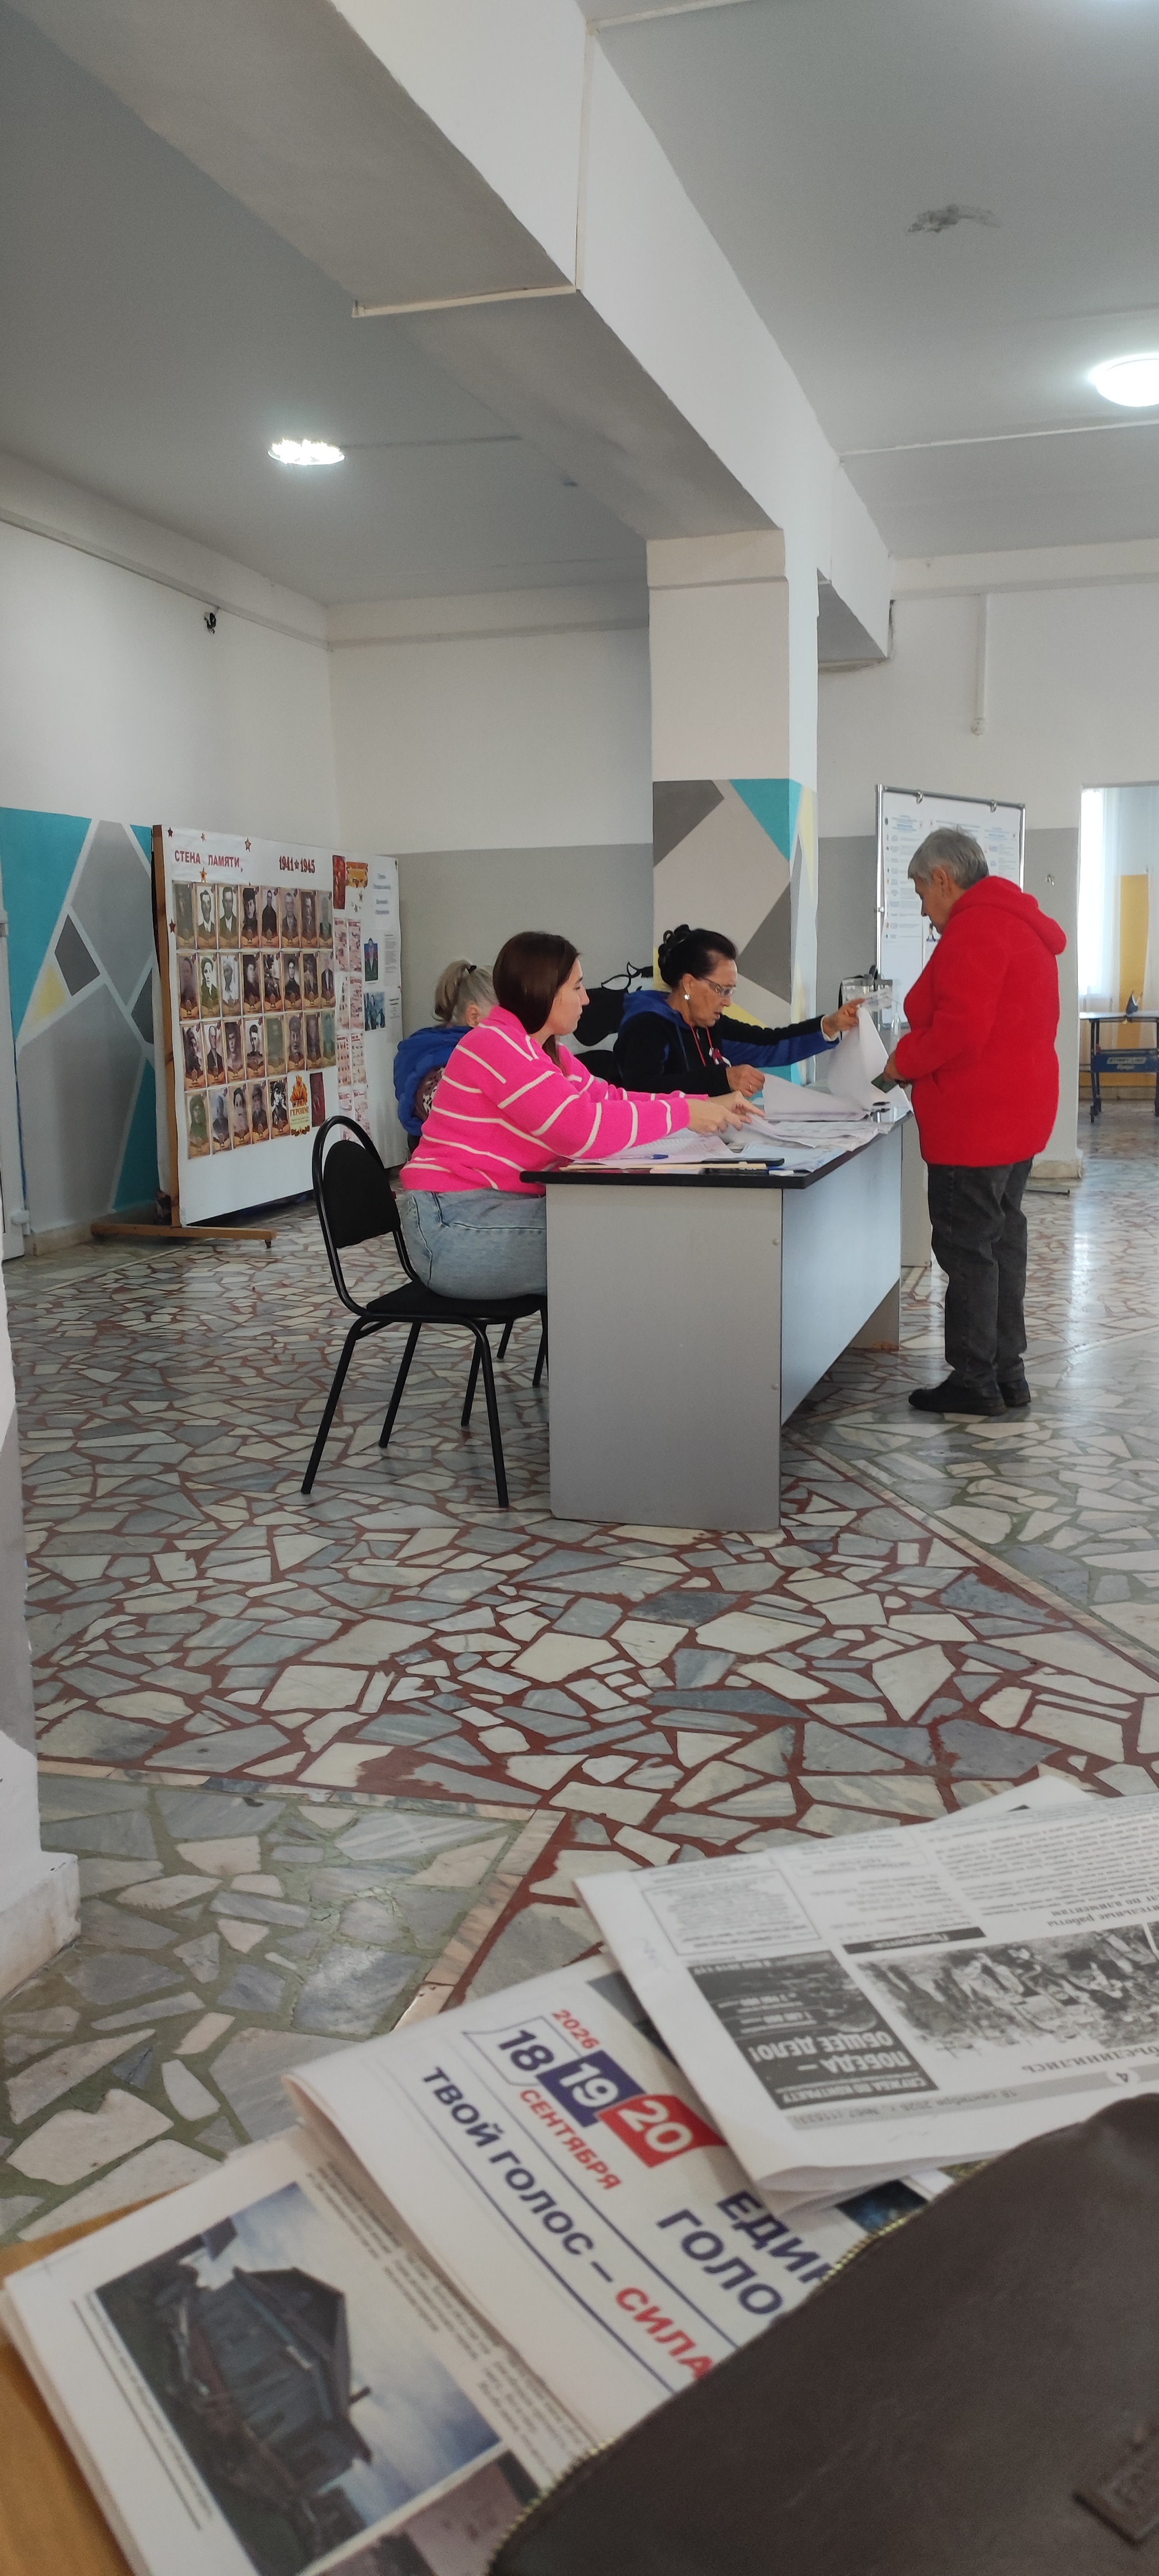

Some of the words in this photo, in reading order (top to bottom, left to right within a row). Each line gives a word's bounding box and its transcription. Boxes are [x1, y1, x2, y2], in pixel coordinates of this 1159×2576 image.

[174, 850, 201, 864] СТЕНА
[208, 854, 240, 868] ПАМЯТИ
[279, 856, 294, 871] 1941
[300, 859, 315, 873] 1945
[1051, 1900, 1122, 1916] алиментам
[1047, 1913, 1096, 1927] работы
[552, 2009, 600, 2050] 2026
[748, 2035, 818, 2063] ДЕЛО!
[817, 2031, 893, 2053] ОБЩЕЕ
[819, 2050, 912, 2074] ПОБЕДА
[872, 2077, 926, 2092] СЛУЖБА
[1116, 2072, 1128, 2083] 4
[497, 2029, 555, 2071] 18
[559, 2061, 619, 2107] 19
[618, 2100, 693, 2153] 20
[782, 2085, 854, 2104] КОНТРАКТУ
[853, 2082, 873, 2094] ПО
[520, 2089, 622, 2190] СЕНТЯБРЯ
[422, 2066, 505, 2147] ТВОЙ
[488, 2150, 594, 2255] ГОЛОС
[616, 2287, 713, 2380] СИЛА
[656, 2208, 783, 2315] ГОЛО
